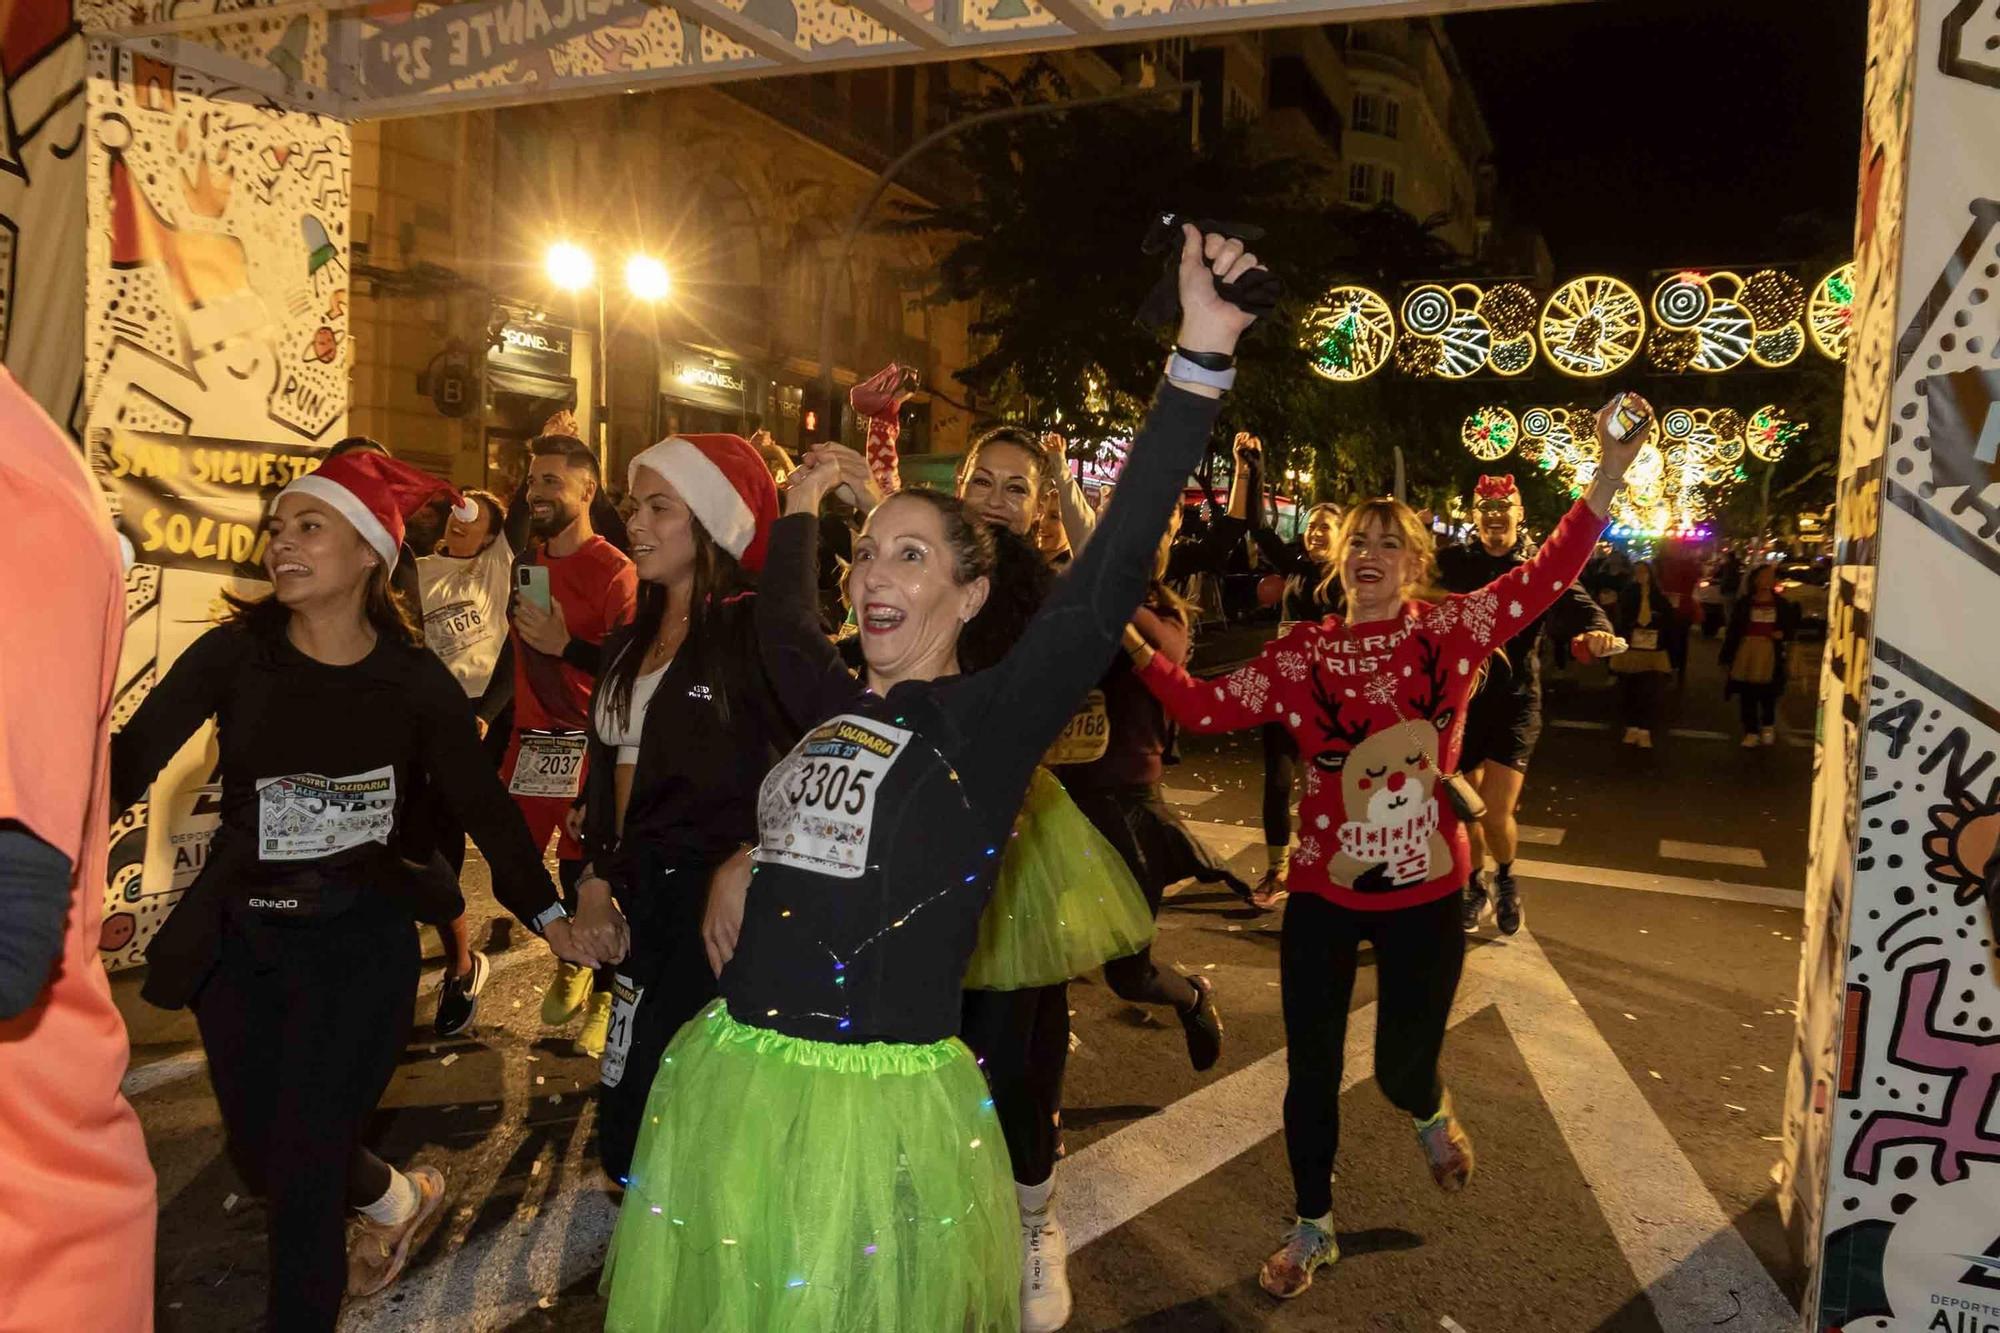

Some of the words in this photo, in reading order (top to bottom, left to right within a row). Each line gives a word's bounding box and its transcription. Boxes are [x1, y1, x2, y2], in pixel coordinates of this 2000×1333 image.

[281, 375, 326, 418] RUN
[446, 610, 481, 636] 1676
[838, 725, 895, 756] SOLIDARIA
[540, 756, 581, 775] 2037
[334, 779, 388, 792] SOLIDARIA
[790, 762, 874, 815] 3305
[1931, 1293, 2000, 1318] DEPORTE
